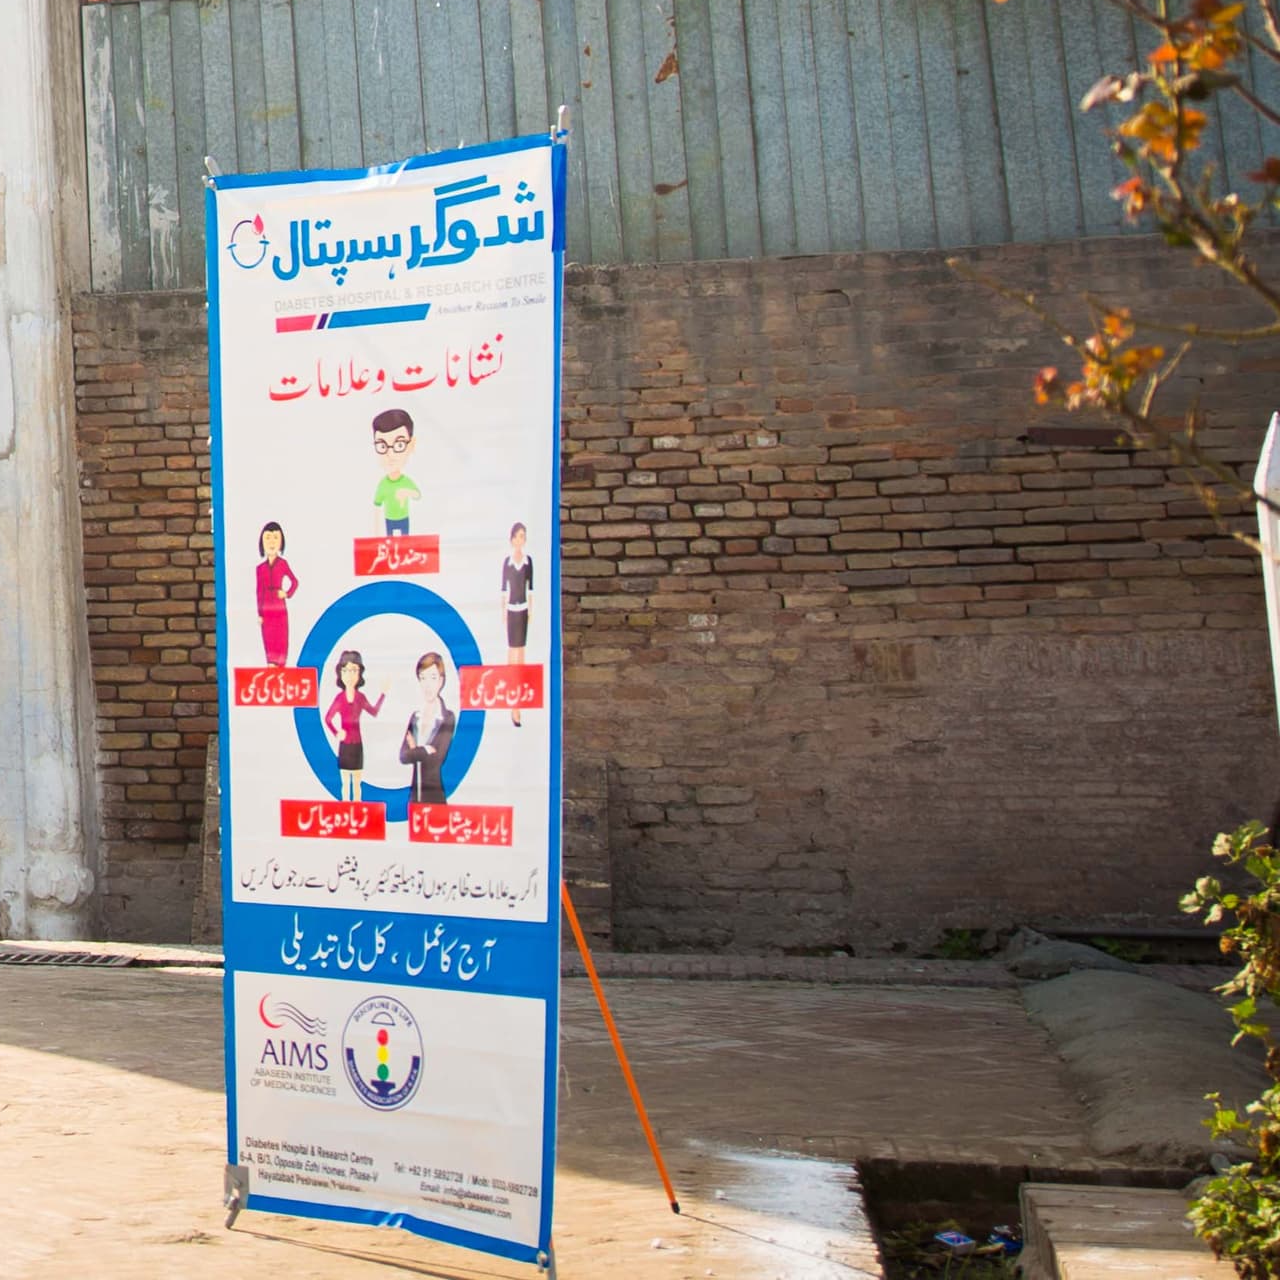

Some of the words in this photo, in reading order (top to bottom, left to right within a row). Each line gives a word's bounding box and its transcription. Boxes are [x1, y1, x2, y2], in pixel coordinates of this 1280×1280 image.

[406, 174, 545, 270] شوگر
[272, 218, 403, 287] ہسپتال
[274, 294, 336, 314] DIABETES
[338, 288, 401, 306] HOSPITAL
[416, 280, 493, 298] RESEARCH
[496, 271, 547, 291] CENTRE
[391, 332, 505, 392] نشانات
[268, 355, 371, 402] علامات
[367, 539, 392, 575] نظر
[388, 542, 428, 571] دھندلی
[240, 671, 266, 704] کمی
[256, 673, 276, 704] کی
[272, 671, 312, 704] توانائی
[469, 668, 494, 707] کمی
[483, 679, 508, 707] میں
[506, 683, 535, 706] وزن
[297, 803, 335, 836] پیاس
[333, 805, 370, 835] زیادہ
[412, 806, 433, 834] آنا
[427, 810, 473, 843] پیشاب
[472, 814, 491, 843] بار
[491, 814, 510, 844] بار
[240, 857, 277, 892] کریں
[271, 864, 306, 890] رجوع
[304, 875, 326, 889] سے
[326, 855, 371, 902] پروفیشنل
[415, 870, 425, 896] تو
[423, 878, 448, 900] ہوں
[444, 872, 471, 903] ظاہر
[470, 878, 510, 901] علامات
[520, 867, 540, 902] اگر
[507, 893, 519, 909] یہ
[279, 911, 339, 971] تبدیلی
[336, 919, 364, 971] کی
[356, 920, 394, 973] کل
[439, 936, 459, 973] کا
[456, 936, 498, 982] آج
[260, 1038, 330, 1072] AIMS
[249, 1078, 263, 1089] OF
[263, 1079, 300, 1093] MEDICAL
[299, 1082, 338, 1098] SCIENCES
[253, 1067, 293, 1082] ABASEEN
[294, 1070, 332, 1086] INSTITUTE
[245, 1136, 280, 1152] Diabetes
[280, 1140, 310, 1157] Hospital
[317, 1146, 349, 1162] Research
[349, 1151, 375, 1167] Centre
[274, 1155, 304, 1171] Opposite
[257, 1168, 296, 1185] Hayatabad
